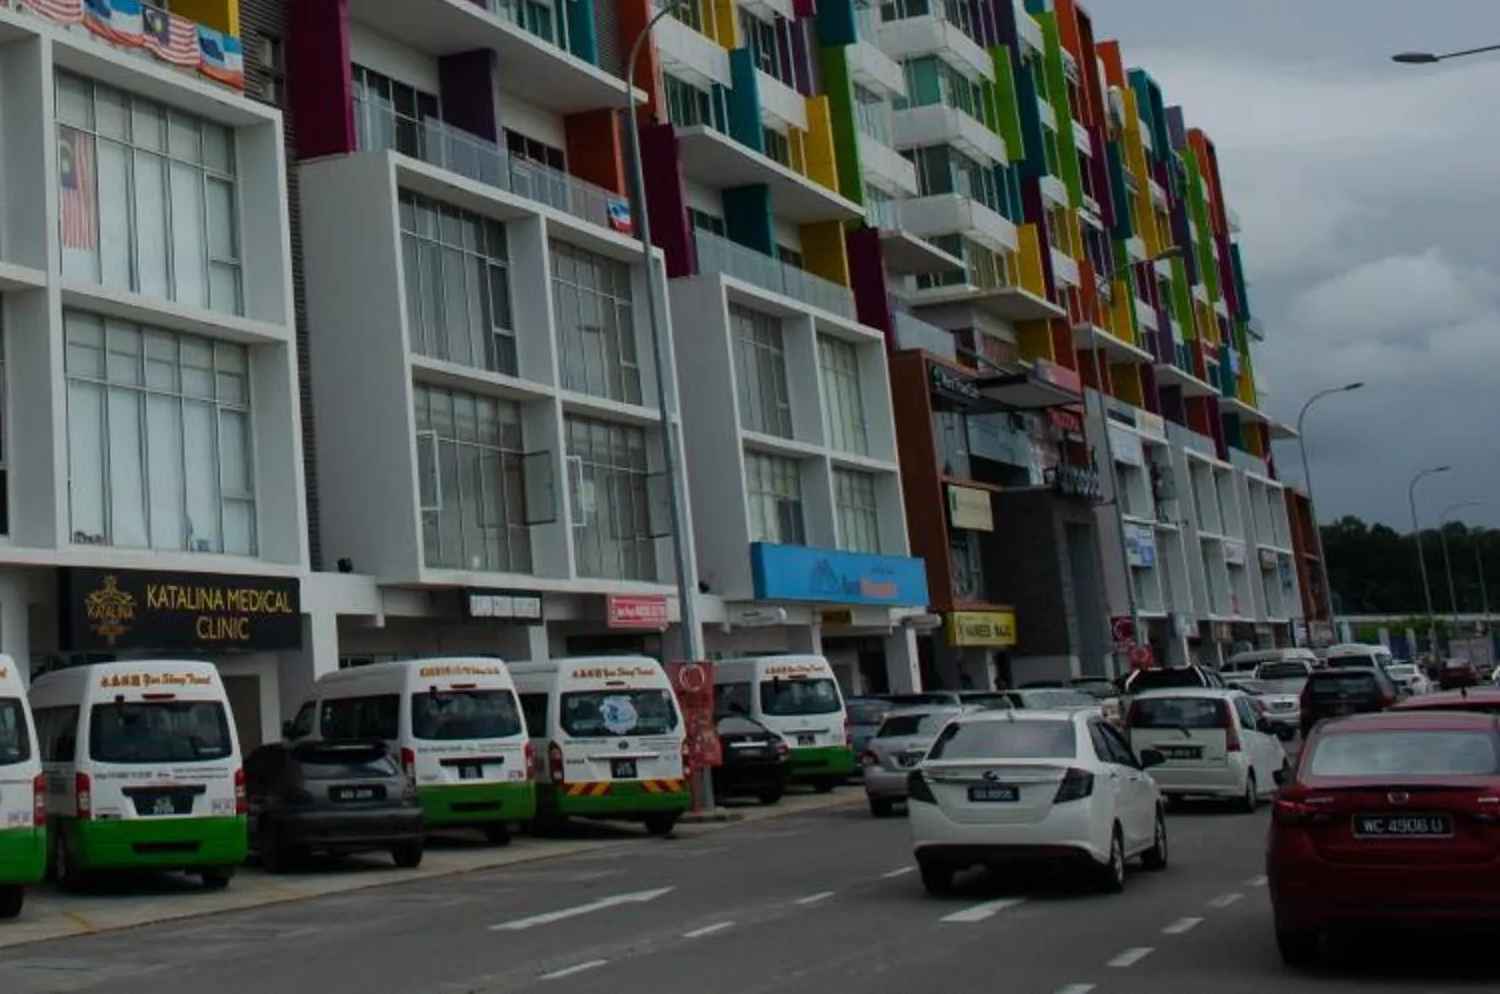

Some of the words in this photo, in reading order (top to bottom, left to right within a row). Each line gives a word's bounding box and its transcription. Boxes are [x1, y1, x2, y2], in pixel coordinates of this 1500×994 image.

[146, 583, 225, 611] KATALINA
[227, 588, 293, 613] MEDICAL
[195, 615, 250, 640] CLINIC
